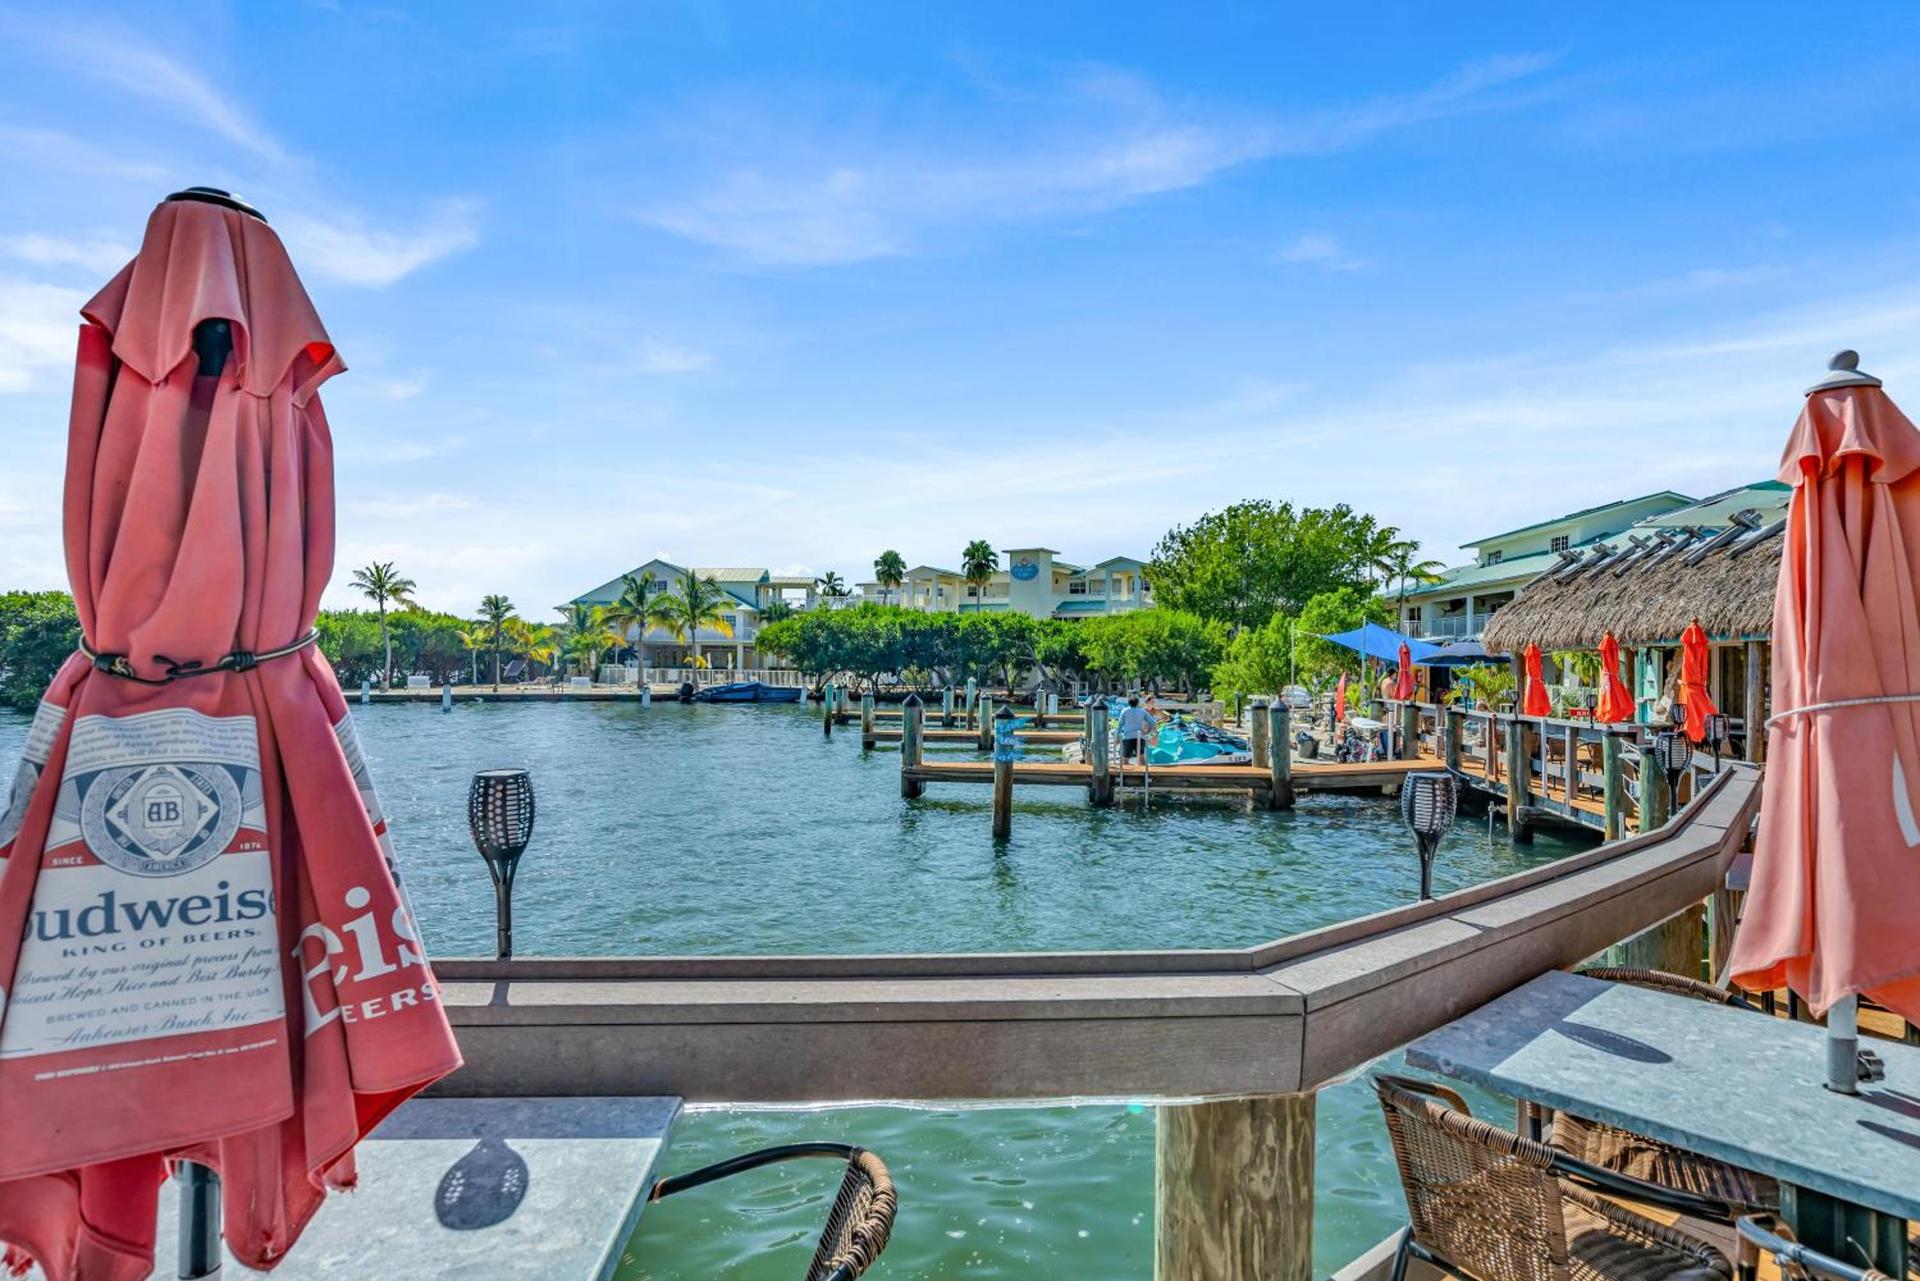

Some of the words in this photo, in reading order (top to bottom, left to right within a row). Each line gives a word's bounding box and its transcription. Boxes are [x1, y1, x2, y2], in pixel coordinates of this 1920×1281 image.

[52, 856, 83, 866] SINCE
[22, 880, 276, 942] udweis
[62, 942, 127, 958] KING
[140, 937, 169, 949] OF
[46, 1008, 106, 1024] BREWED
[111, 1002, 140, 1014] AND
[143, 996, 197, 1011] CANNED
[218, 990, 241, 1001] THE
[341, 982, 440, 1023] EERS
